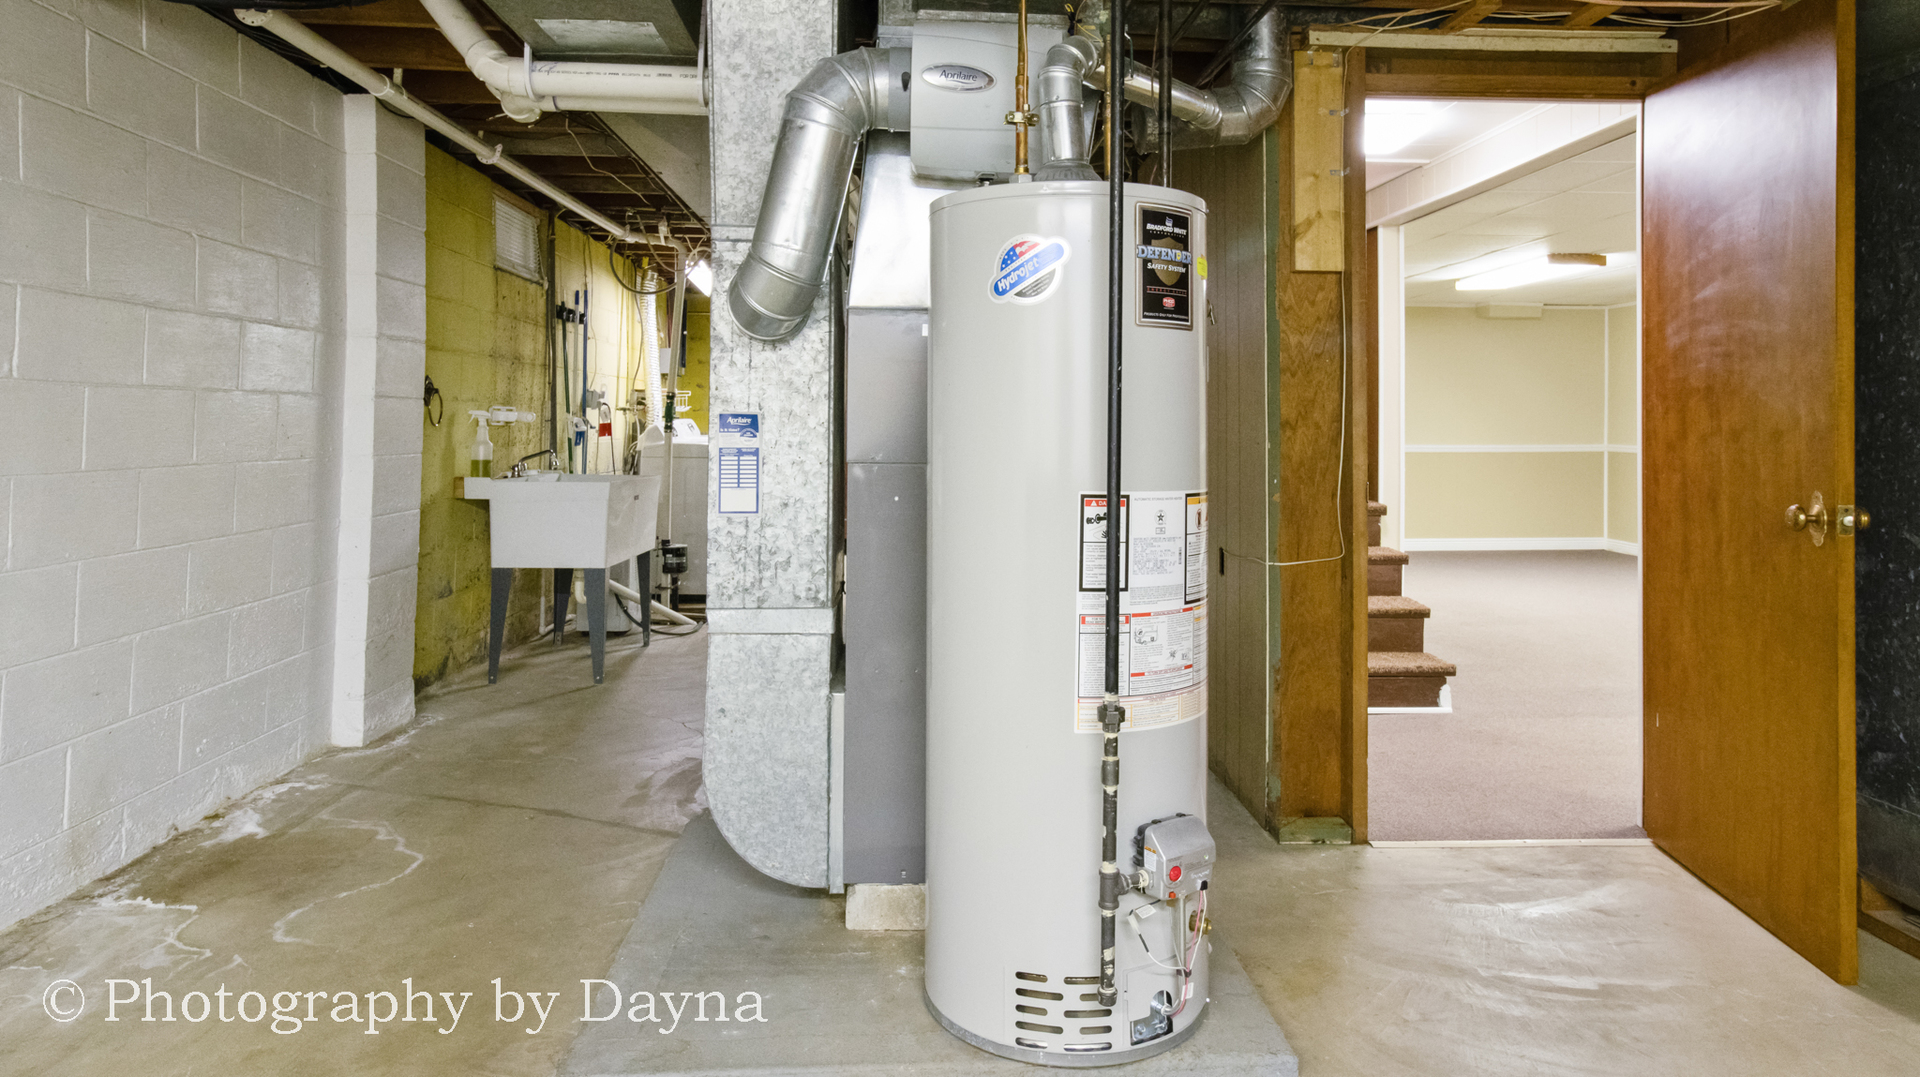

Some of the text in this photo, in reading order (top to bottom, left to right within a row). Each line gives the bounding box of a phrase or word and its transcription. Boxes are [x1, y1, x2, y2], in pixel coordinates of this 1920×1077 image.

[939, 69, 978, 82] Aprilaire
[1146, 223, 1187, 236] BRADFORD WHITE
[1137, 245, 1192, 264] DEFENDER
[1147, 262, 1187, 273] SAFETY SYSTEM
[997, 257, 1039, 292] Hydrojet
[726, 416, 752, 425] Aprilaire
